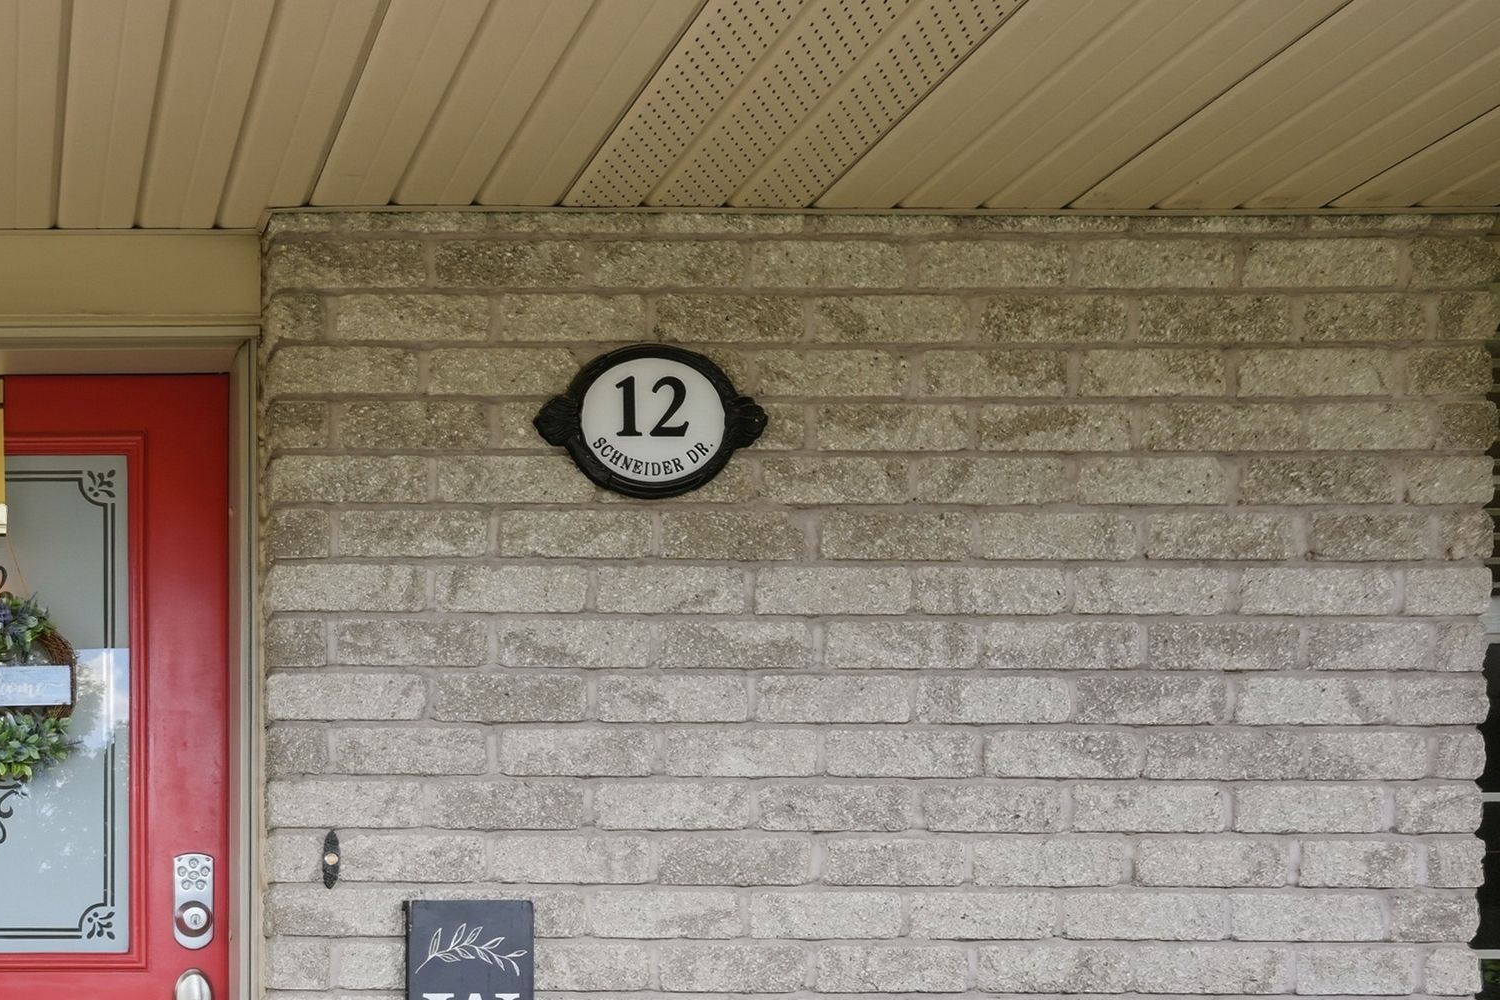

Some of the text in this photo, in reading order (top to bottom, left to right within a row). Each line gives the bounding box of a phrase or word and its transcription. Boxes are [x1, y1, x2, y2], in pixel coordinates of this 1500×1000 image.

[615, 376, 690, 437] 12
[592, 436, 714, 476] SCHNEIDER DR.
